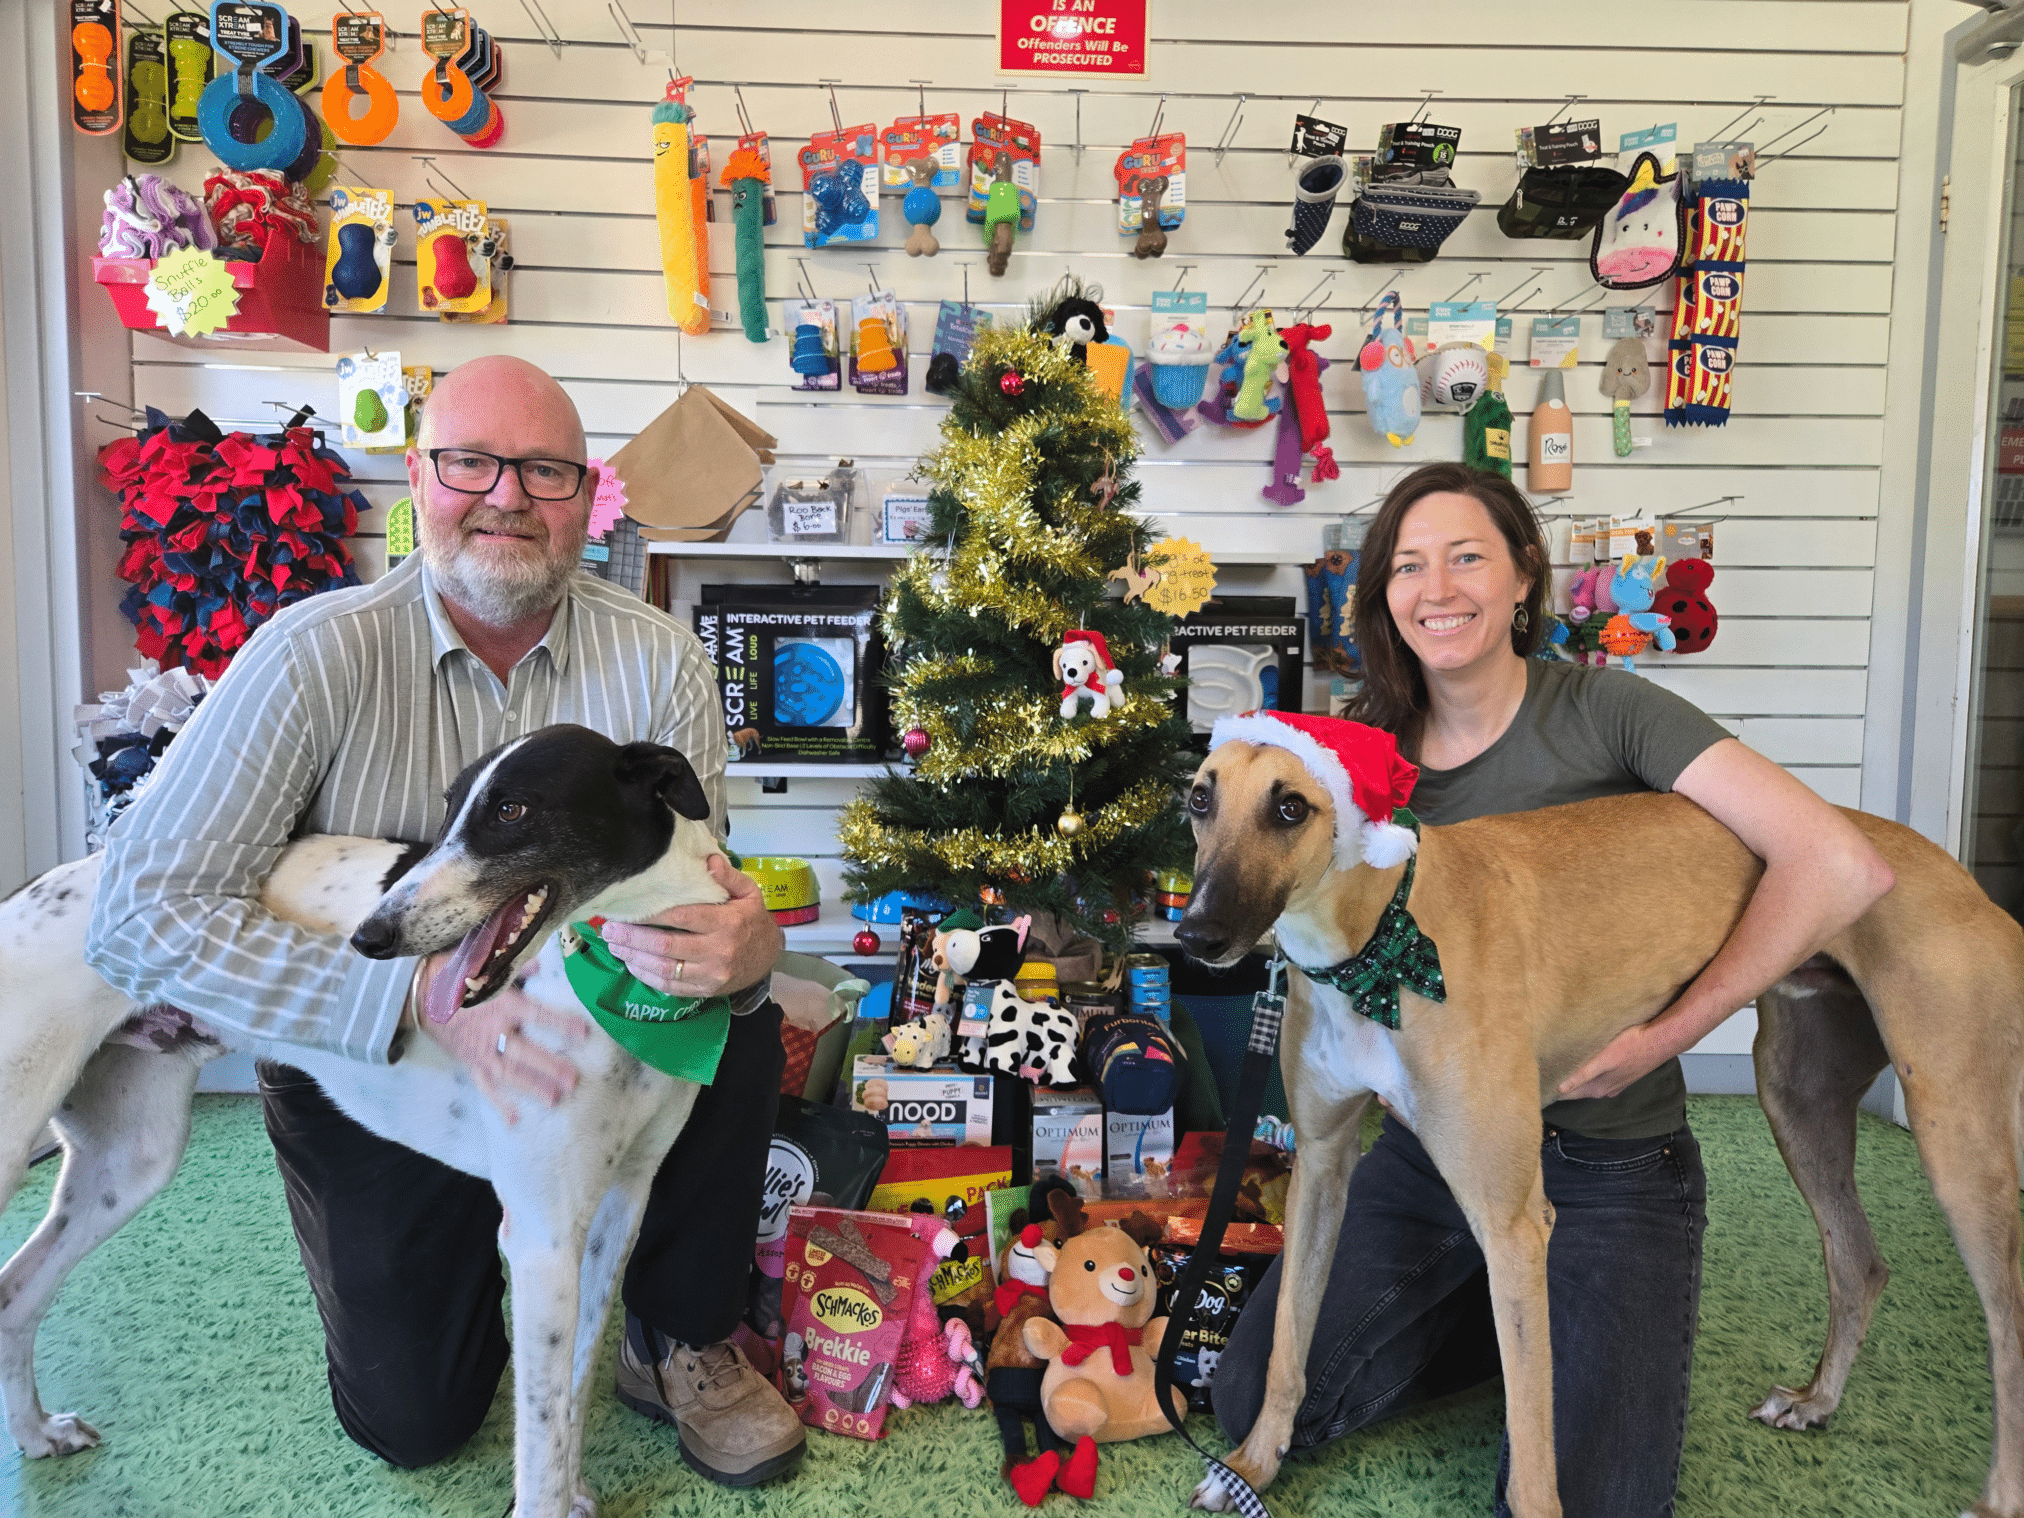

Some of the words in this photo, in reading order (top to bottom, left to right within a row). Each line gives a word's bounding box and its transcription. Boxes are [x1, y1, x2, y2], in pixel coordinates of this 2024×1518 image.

[1053, 0, 1066, 11] IS
[1071, 0, 1095, 12] AN
[218, 22, 246, 31] XTREM
[1030, 15, 1117, 34] OFFENCE
[1017, 38, 1081, 51] Offenders
[1085, 40, 1109, 52] Will
[1112, 41, 1129, 53] Be
[1033, 52, 1113, 66] PROSECUTED
[1436, 127, 1459, 139] DOOG
[1715, 202, 1737, 212] PAWP
[1716, 211, 1737, 222] CORN
[155, 258, 208, 291] Snuffle
[1709, 276, 1732, 287] PAWP
[1710, 286, 1732, 297] CORN
[1706, 348, 1726, 360] PAWP
[1708, 358, 1727, 370] CORN
[726, 613, 802, 625] INTERACTIVE
[803, 614, 826, 626] PET
[827, 614, 871, 626] FEEDER
[1225, 625, 1248, 637] PET
[1250, 625, 1297, 637] FEEDER
[749, 634, 758, 661] LOUD
[725, 626, 746, 726] SCREAM
[749, 671, 758, 690] LIFE
[749, 701, 758, 720] LIVE
[624, 1000, 669, 1021] YAPPY
[1035, 1127, 1099, 1138] OPTIMUM
[1109, 1120, 1171, 1134] OPTIMUM
[966, 1175, 1008, 1202] PACK
[1194, 1288, 1226, 1315] Dog
[816, 1293, 880, 1327] SCHMACKOS
[1199, 1330, 1229, 1346] Bite
[804, 1326, 871, 1367] Brekkie
[812, 1362, 832, 1376] BACON
[838, 1371, 852, 1382] EGG
[813, 1372, 847, 1389] FLAVOURS
